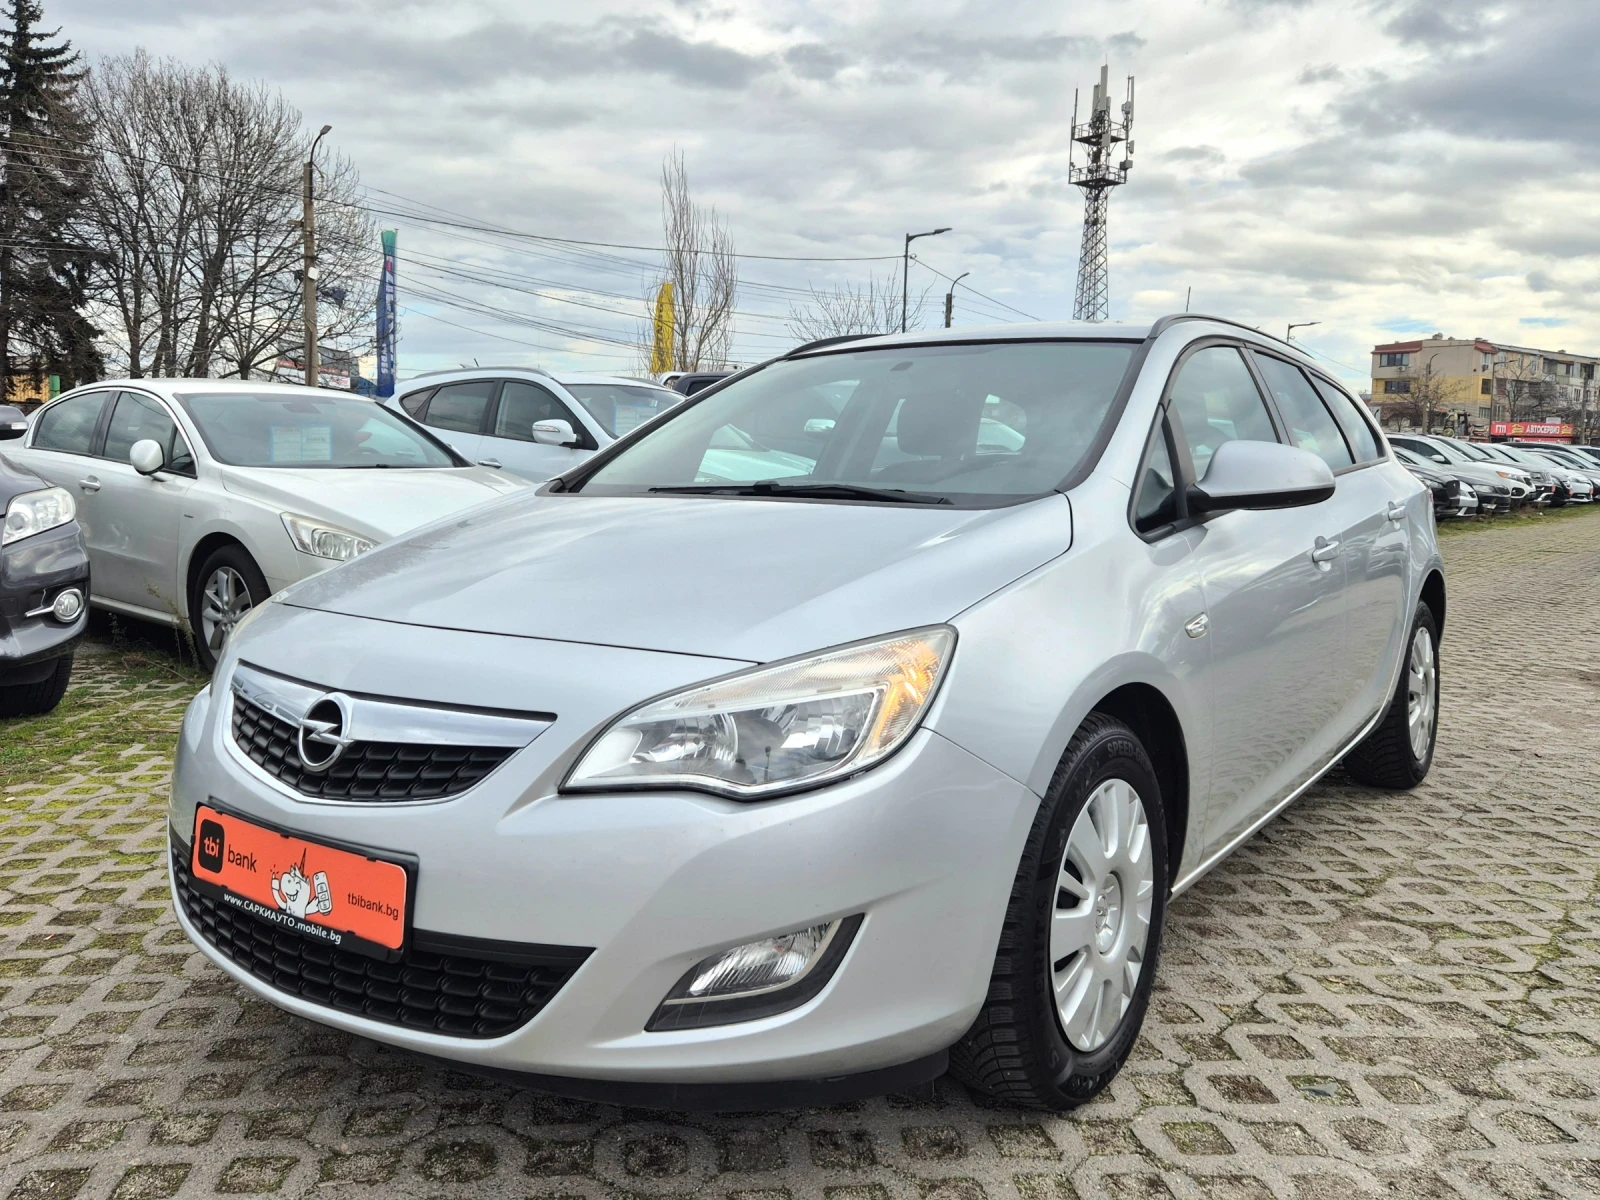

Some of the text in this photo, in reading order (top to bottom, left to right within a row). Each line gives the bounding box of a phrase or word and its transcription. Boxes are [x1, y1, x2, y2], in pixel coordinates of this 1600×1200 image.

[1526, 424, 1560, 434] АВТОСЕРВИЗ
[204, 837, 257, 873] tbi bank
[347, 893, 399, 920] tbibank.bg
